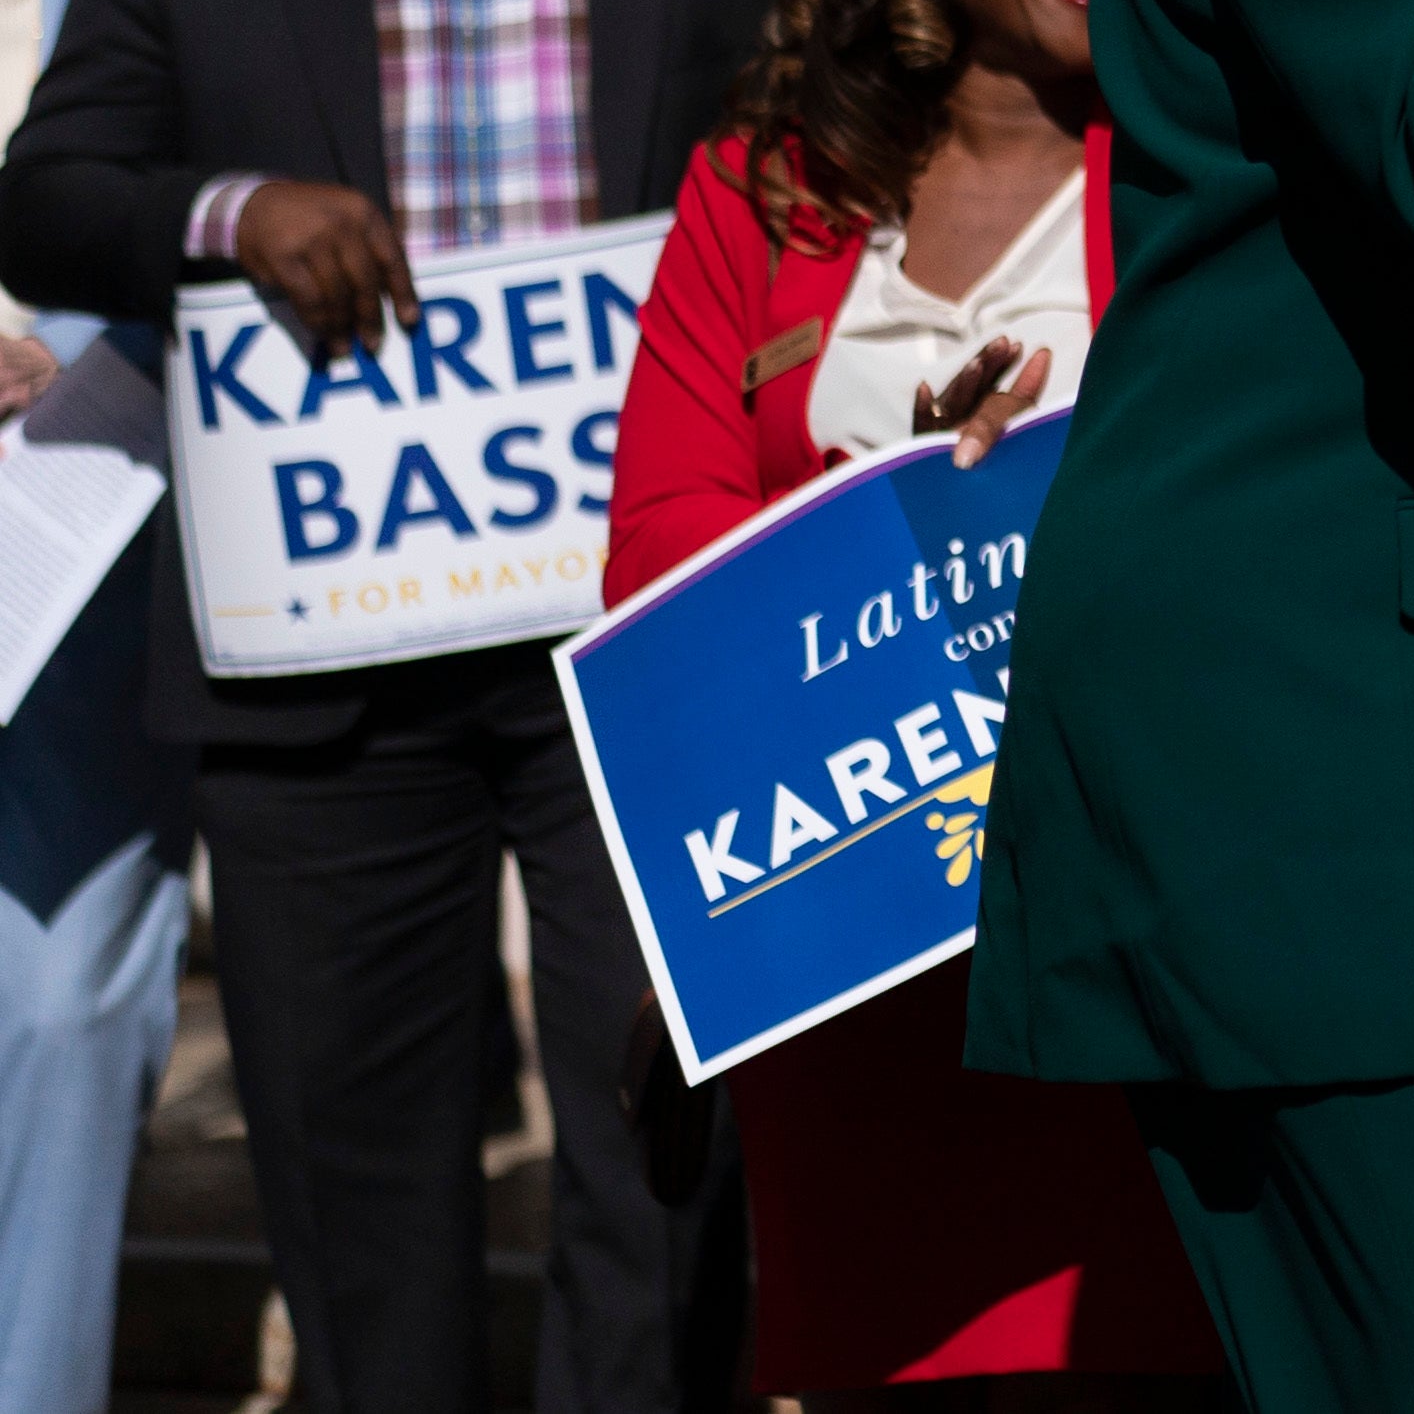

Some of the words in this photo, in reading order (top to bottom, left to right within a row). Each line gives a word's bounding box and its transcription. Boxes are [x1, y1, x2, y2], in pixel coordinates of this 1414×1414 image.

[326, 582, 425, 619] FOR
[448, 549, 609, 600] MAYO
[799, 528, 1027, 685] Latin
